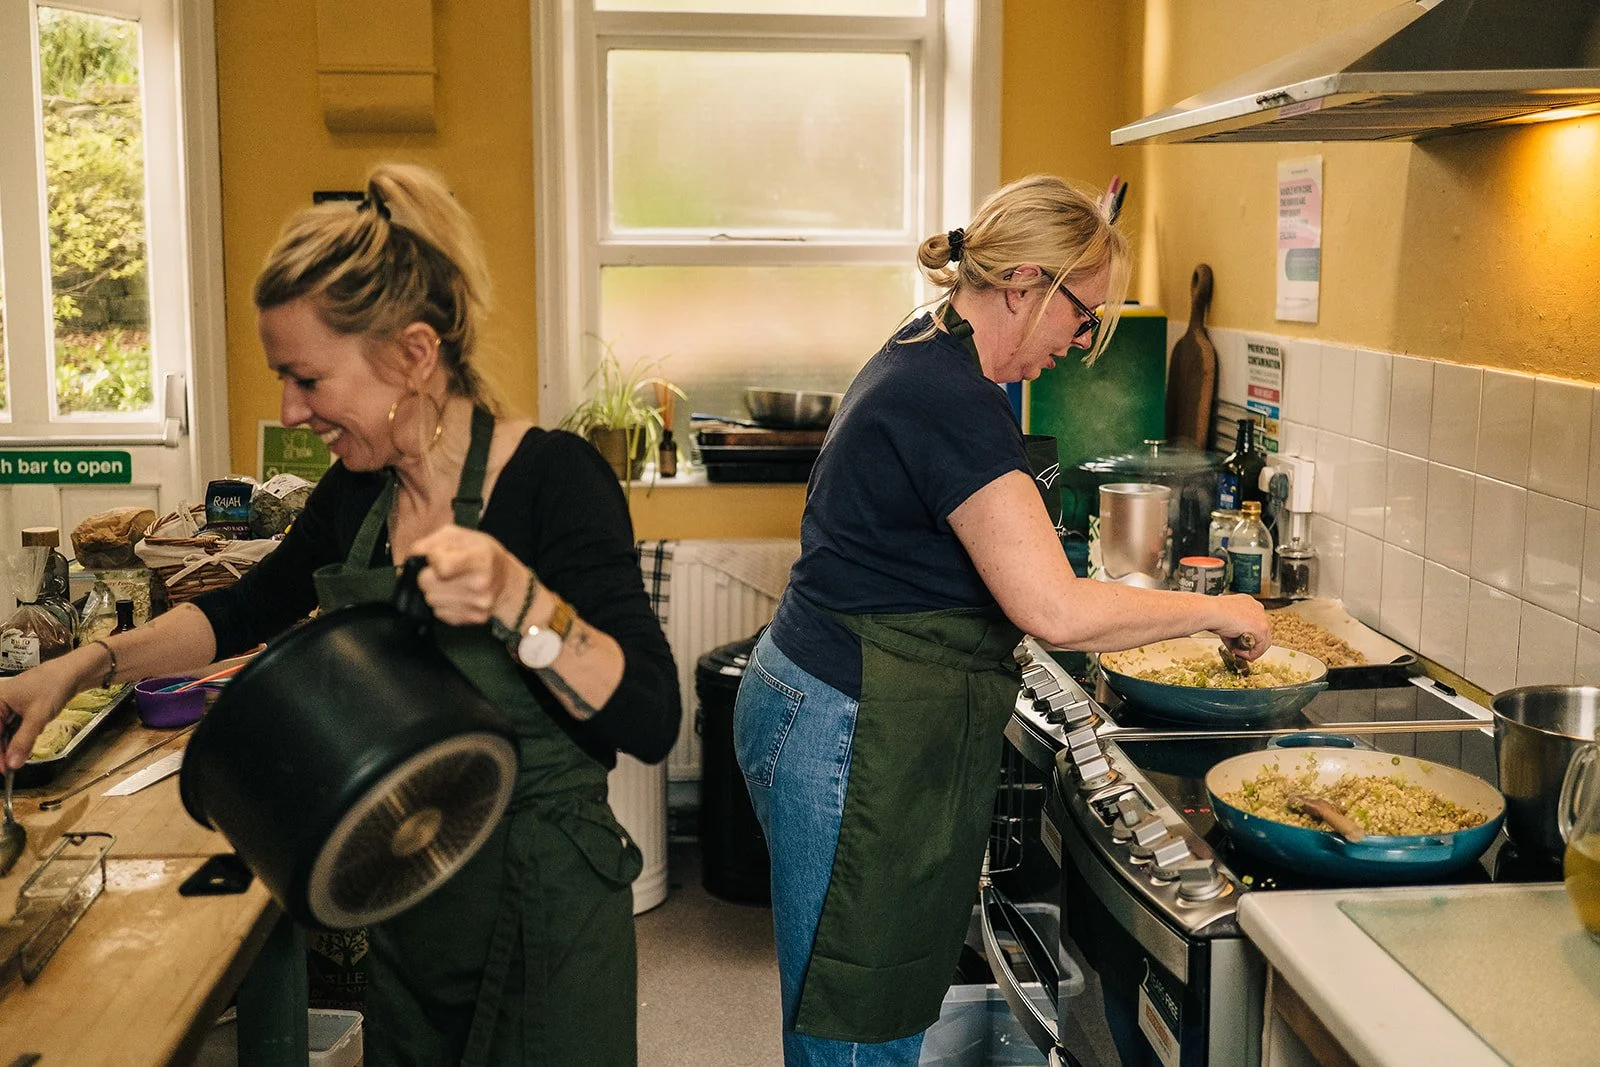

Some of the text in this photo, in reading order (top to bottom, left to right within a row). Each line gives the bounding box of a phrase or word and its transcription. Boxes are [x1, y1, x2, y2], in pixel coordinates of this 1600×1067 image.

[1265, 345, 1280, 357] CROSS
[1247, 356, 1281, 370] CONTAMINATION
[18, 458, 48, 474] bar
[53, 458, 72, 474] to
[77, 460, 123, 477] open
[213, 495, 241, 508] RAJAH
